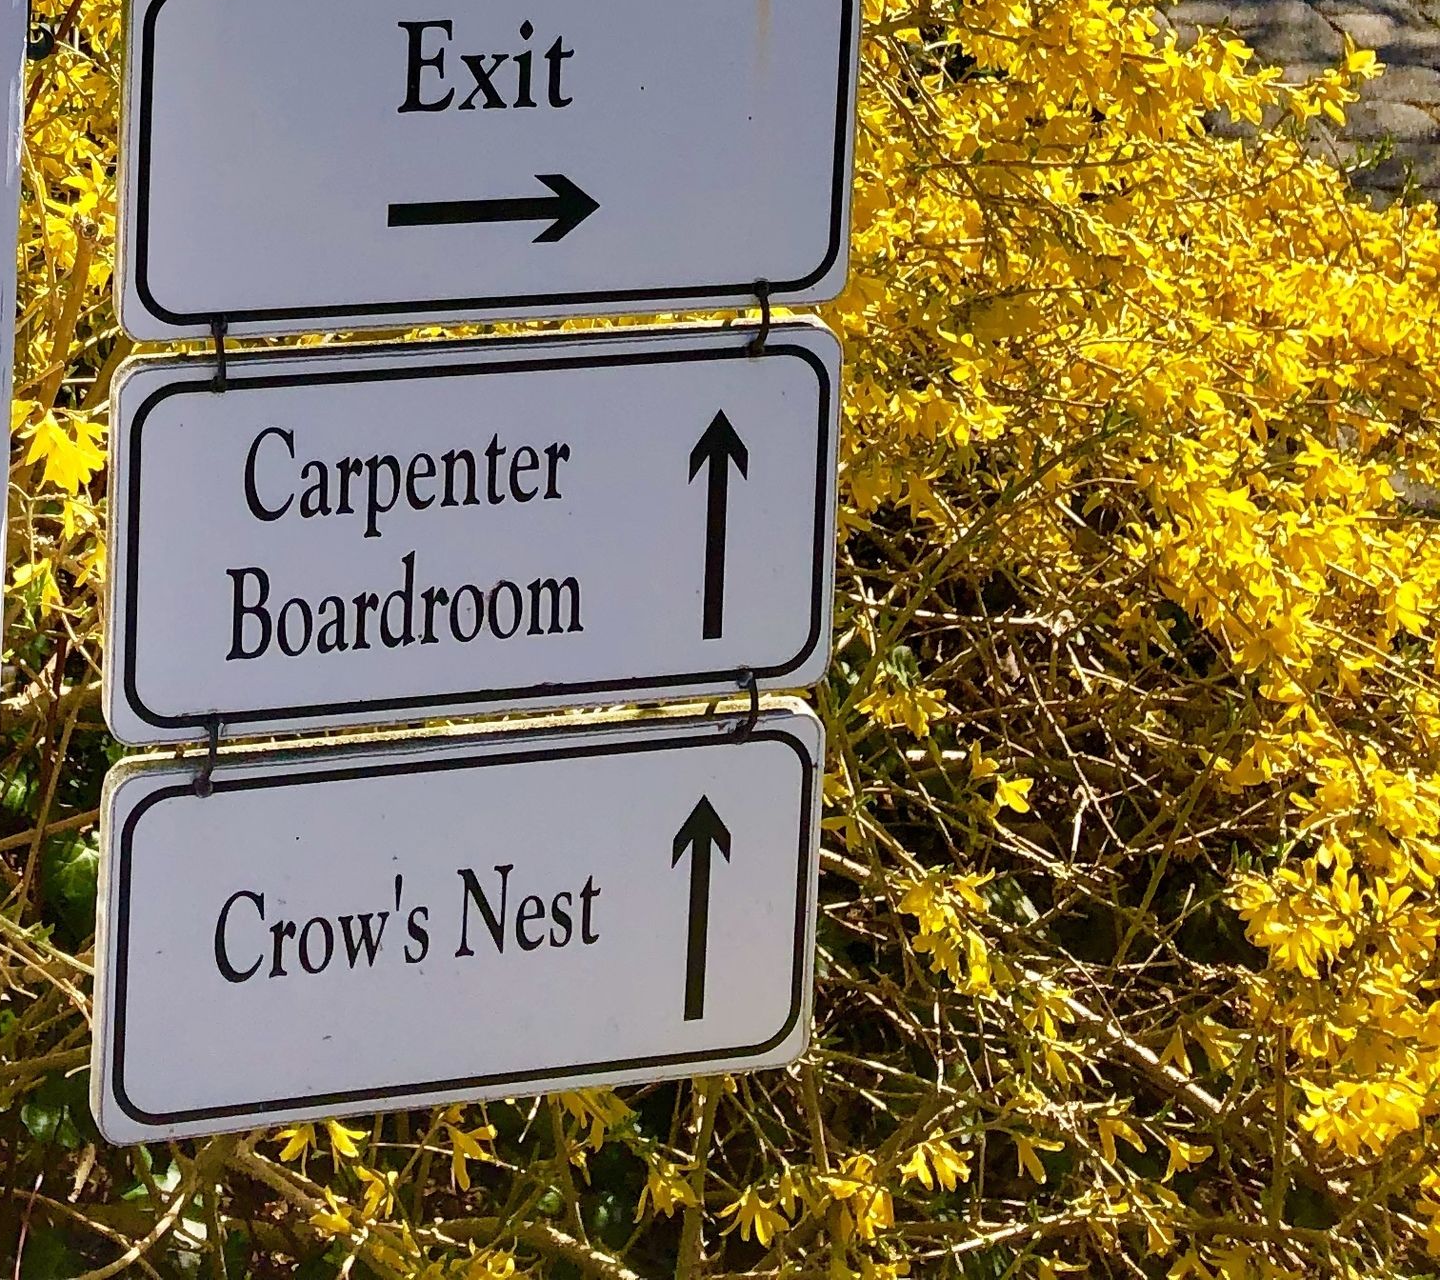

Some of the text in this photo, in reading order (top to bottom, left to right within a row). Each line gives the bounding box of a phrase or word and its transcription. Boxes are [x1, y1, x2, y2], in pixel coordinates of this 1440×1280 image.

[396, 18, 575, 114] Exit
[244, 426, 571, 539] Carpenter
[225, 550, 585, 662] Boardroom
[214, 863, 602, 984] Crow's Nest
